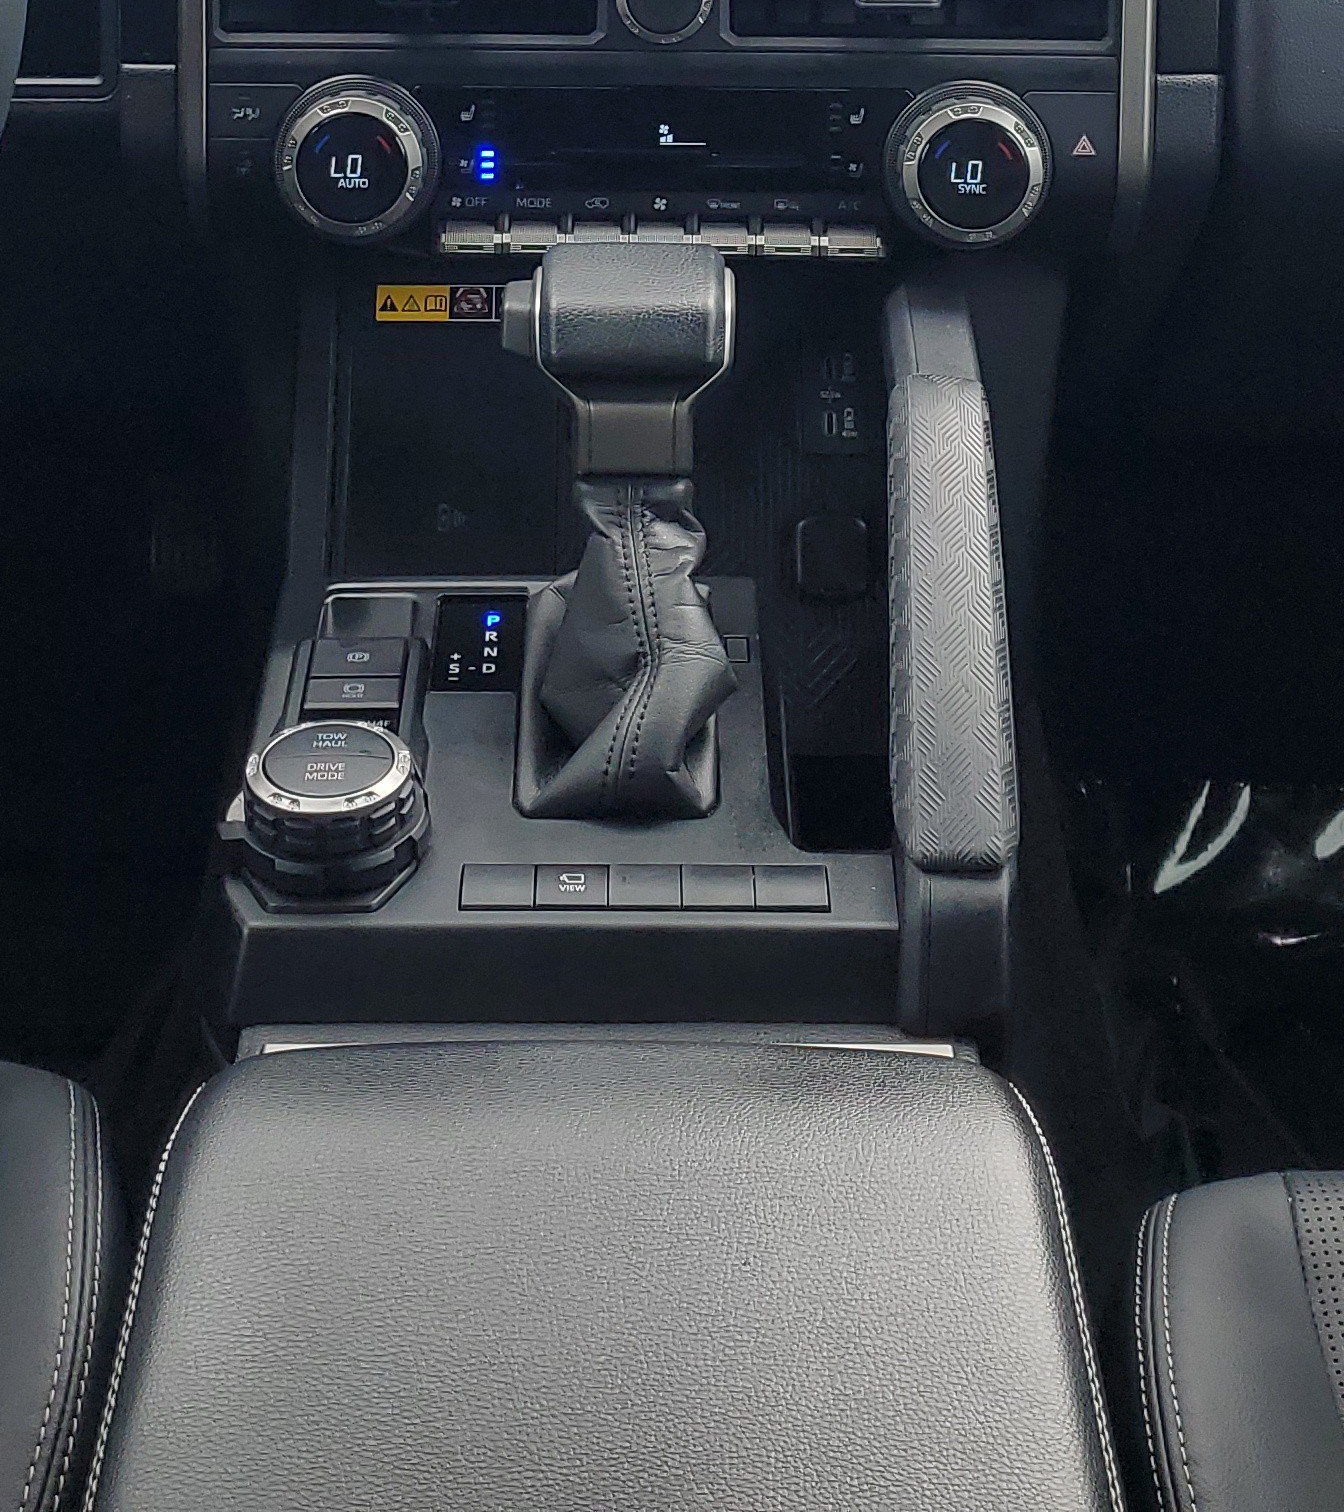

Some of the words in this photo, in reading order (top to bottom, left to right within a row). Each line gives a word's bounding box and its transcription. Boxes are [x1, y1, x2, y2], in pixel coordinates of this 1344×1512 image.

[337, 178, 369, 189] AUTO
[957, 184, 987, 196] SYNC
[465, 196, 488, 207] OFF
[516, 197, 553, 208] MODE
[486, 614, 501, 627] P
[485, 631, 499, 642] R
[483, 647, 498, 658] N
[449, 663, 461, 674] S
[482, 663, 496, 674] D
[316, 732, 348, 741] TOW
[312, 740, 348, 748] HAUL
[307, 762, 346, 772] DRIVE
[304, 771, 345, 781] MODE
[558, 884, 586, 892] VIEW
